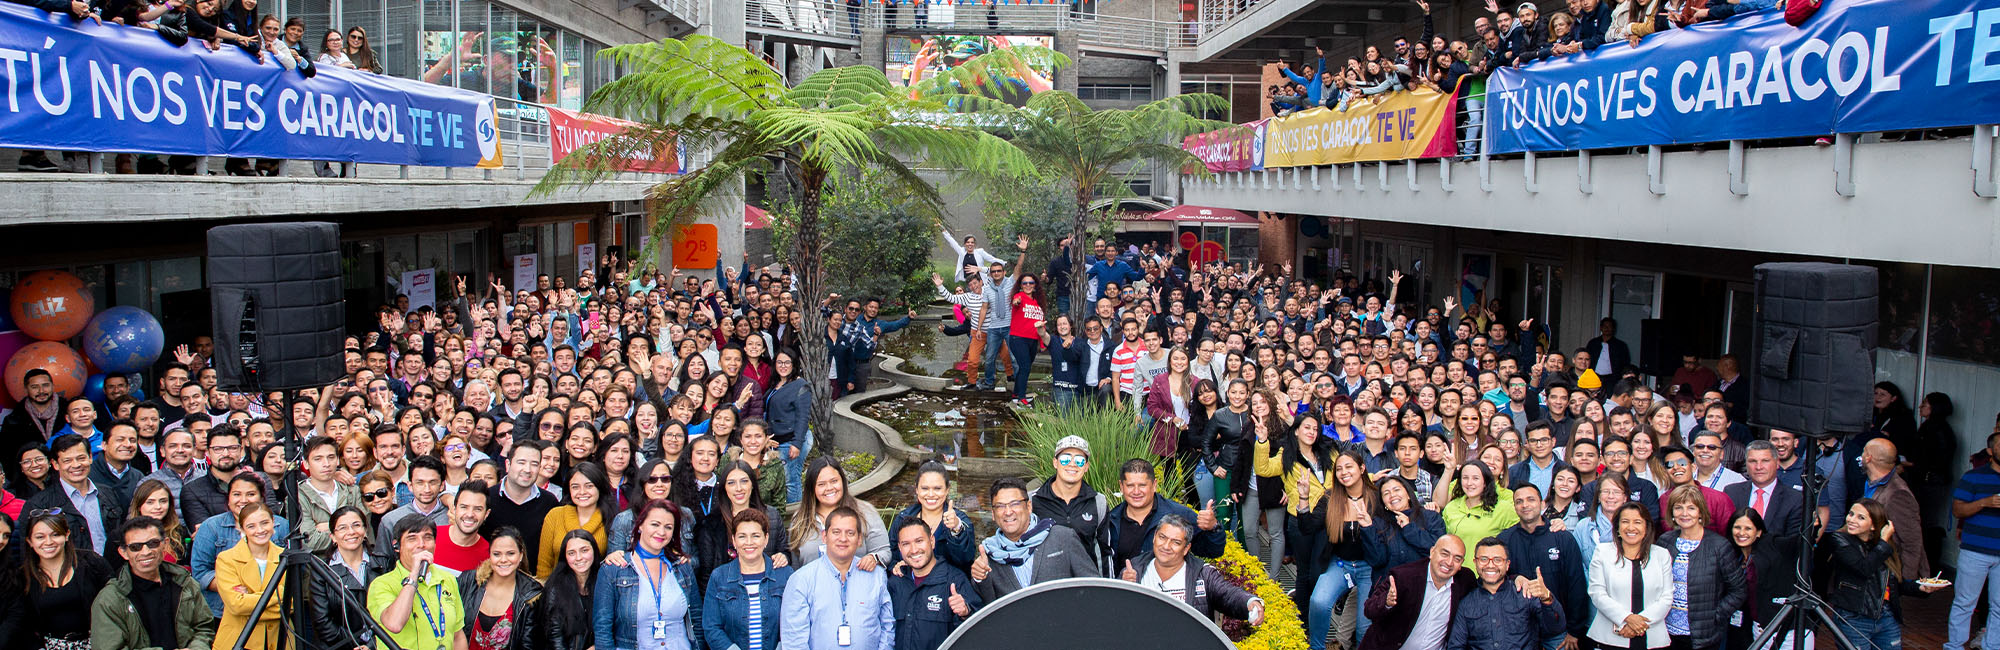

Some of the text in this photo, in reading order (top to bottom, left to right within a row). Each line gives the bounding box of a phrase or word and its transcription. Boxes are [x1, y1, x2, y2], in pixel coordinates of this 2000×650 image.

[0, 36, 465, 149] TÚ NOS VES CARACOL TE VE
[1500, 7, 2000, 131] TÚ NOS VES CARACOL TE
[556, 120, 572, 154] TÚ
[1282, 127, 1299, 154] NOS
[1301, 124, 1319, 152] VES
[1321, 114, 1372, 149] CARACOL
[1377, 111, 1395, 143] TE
[1398, 107, 1417, 142] VE
